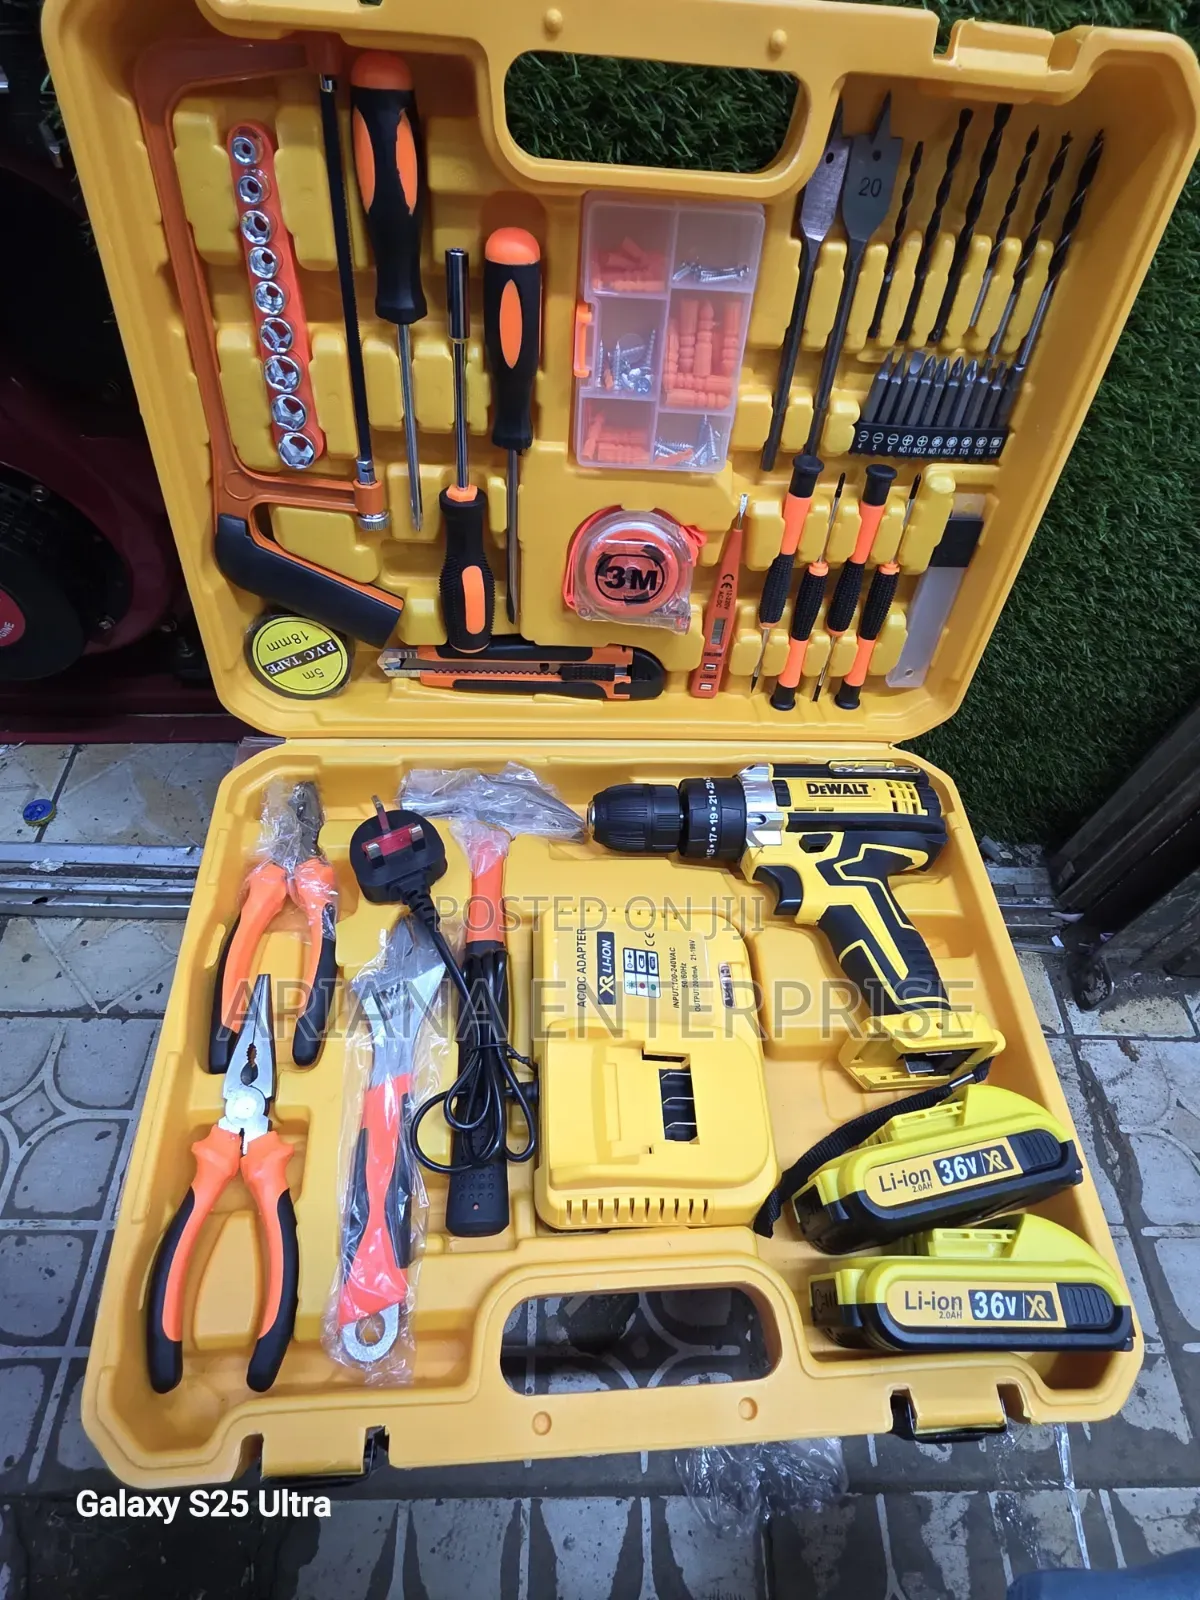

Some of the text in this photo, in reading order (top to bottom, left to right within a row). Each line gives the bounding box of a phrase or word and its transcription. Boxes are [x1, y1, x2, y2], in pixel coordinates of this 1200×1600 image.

[858, 177, 882, 198] 20
[604, 566, 658, 591] 3M
[266, 631, 309, 652] 18mm
[266, 655, 302, 675] TAPE
[302, 668, 325, 680] 5m
[708, 795, 718, 805] 21
[709, 813, 718, 825] 19
[708, 833, 717, 842] 17
[602, 940, 612, 974] LI-ION
[577, 928, 586, 1008] AC/DC ADAPTER
[879, 1168, 932, 1192] Li-ion
[912, 1182, 933, 1193] 2.0AH
[905, 1290, 962, 1311] Li-ion
[939, 1311, 962, 1320] 2.0AH
